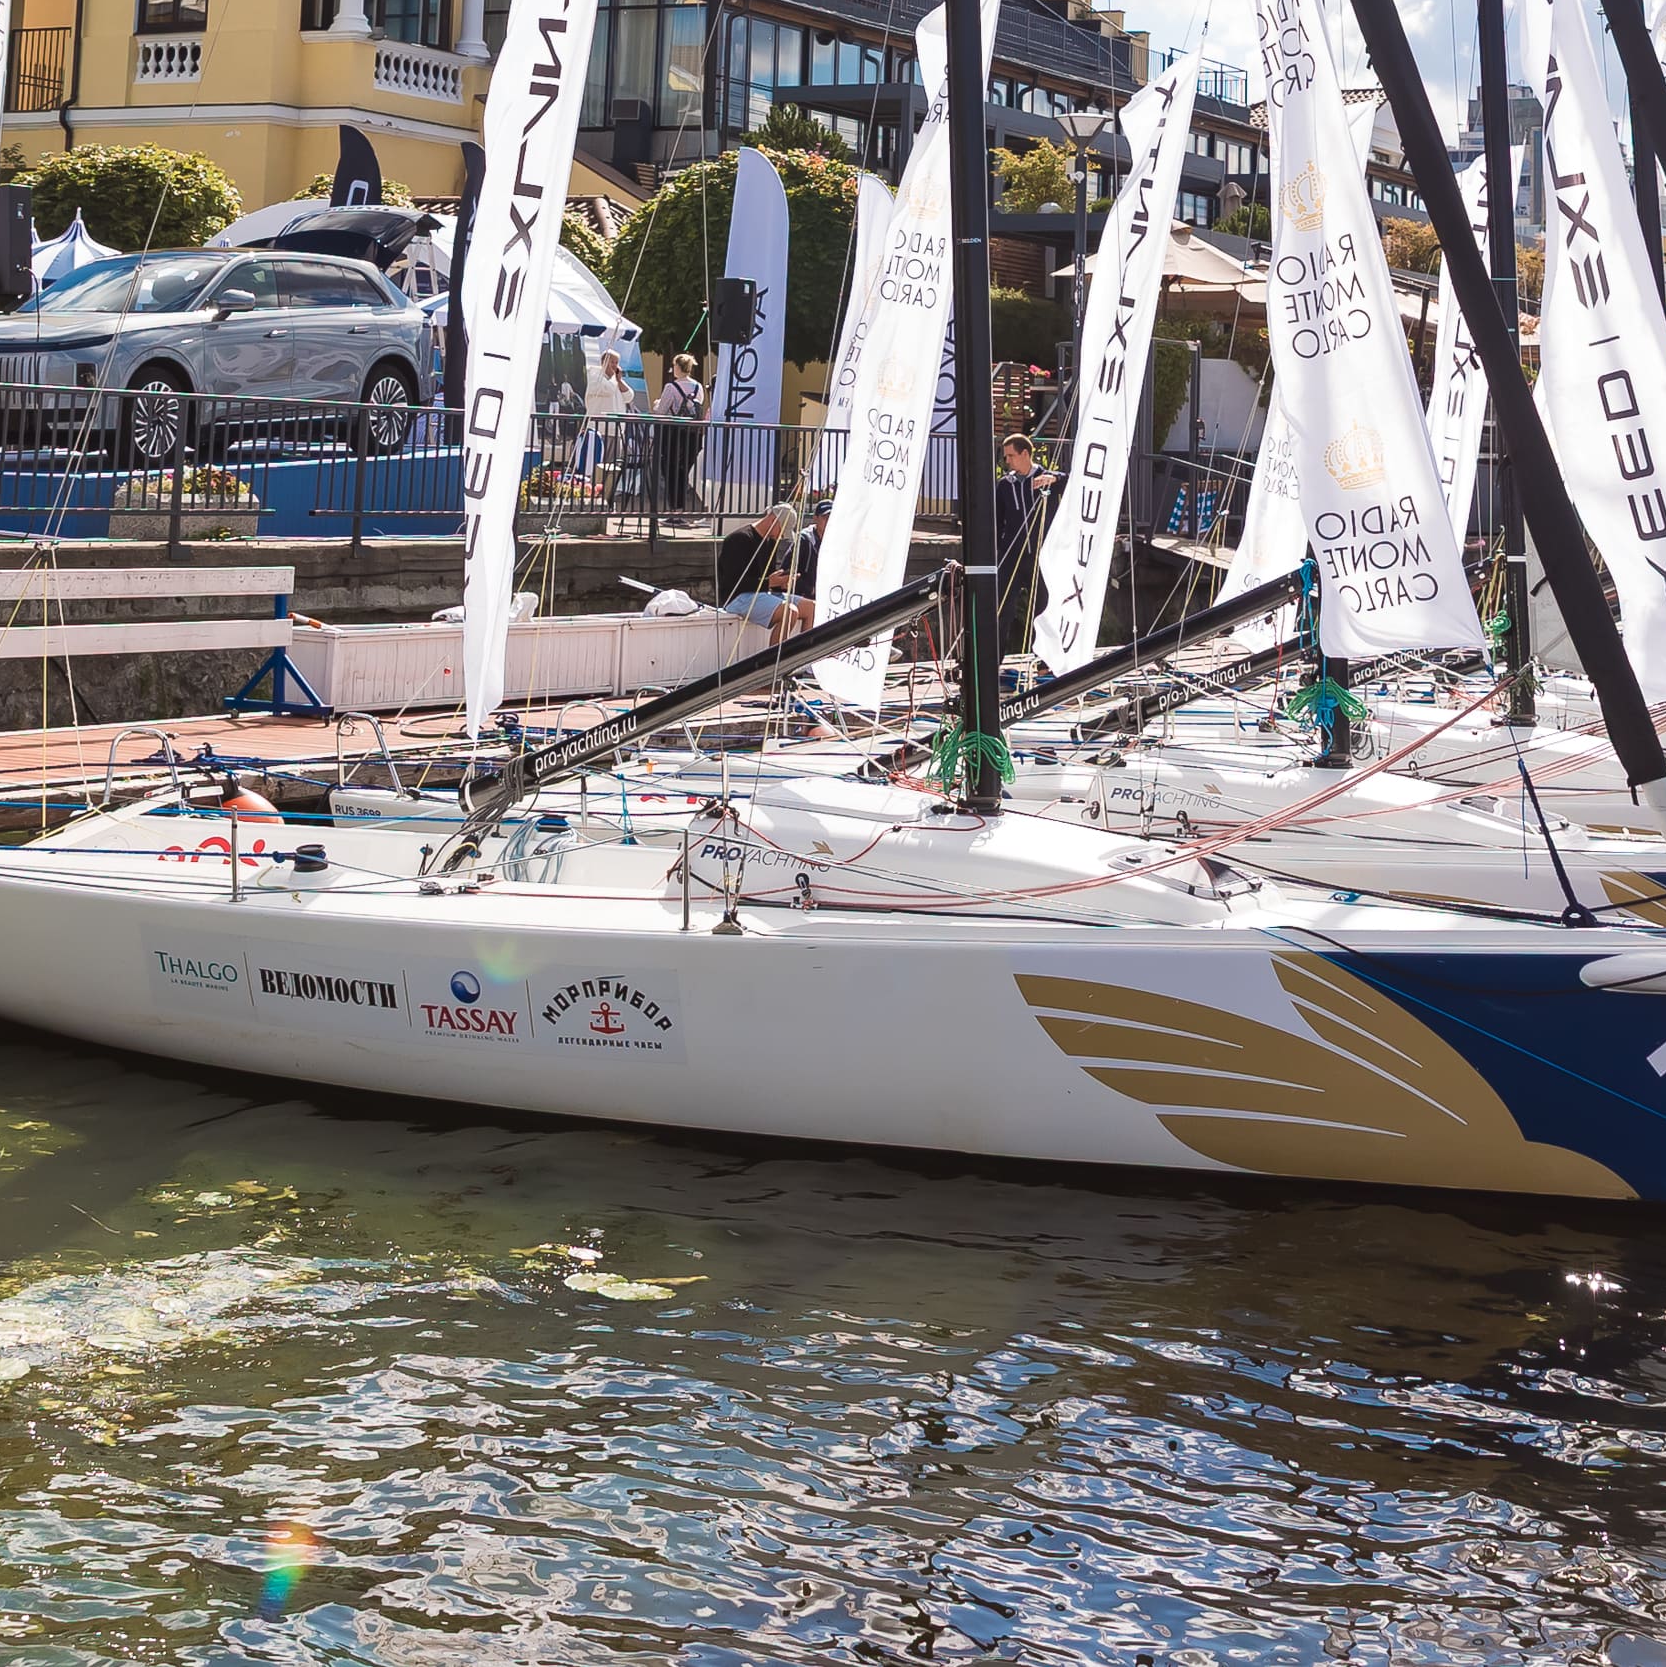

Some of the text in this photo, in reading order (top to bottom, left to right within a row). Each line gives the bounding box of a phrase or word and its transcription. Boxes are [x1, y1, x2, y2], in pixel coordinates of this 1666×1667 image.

[1158, 660, 1252, 712] pro-yachting.ru
[535, 715, 637, 776] pro-yachting.ru
[334, 804, 355, 815] RUS
[153, 950, 238, 983] THALGO
[258, 968, 398, 1010] ВЕДОМОСТИ
[541, 979, 673, 1032] МОРПРИБОР
[420, 1004, 518, 1035] TASSAY
[557, 1036, 663, 1050] ЛЕГЕНДАРНЫЕ ЧАСЫ
